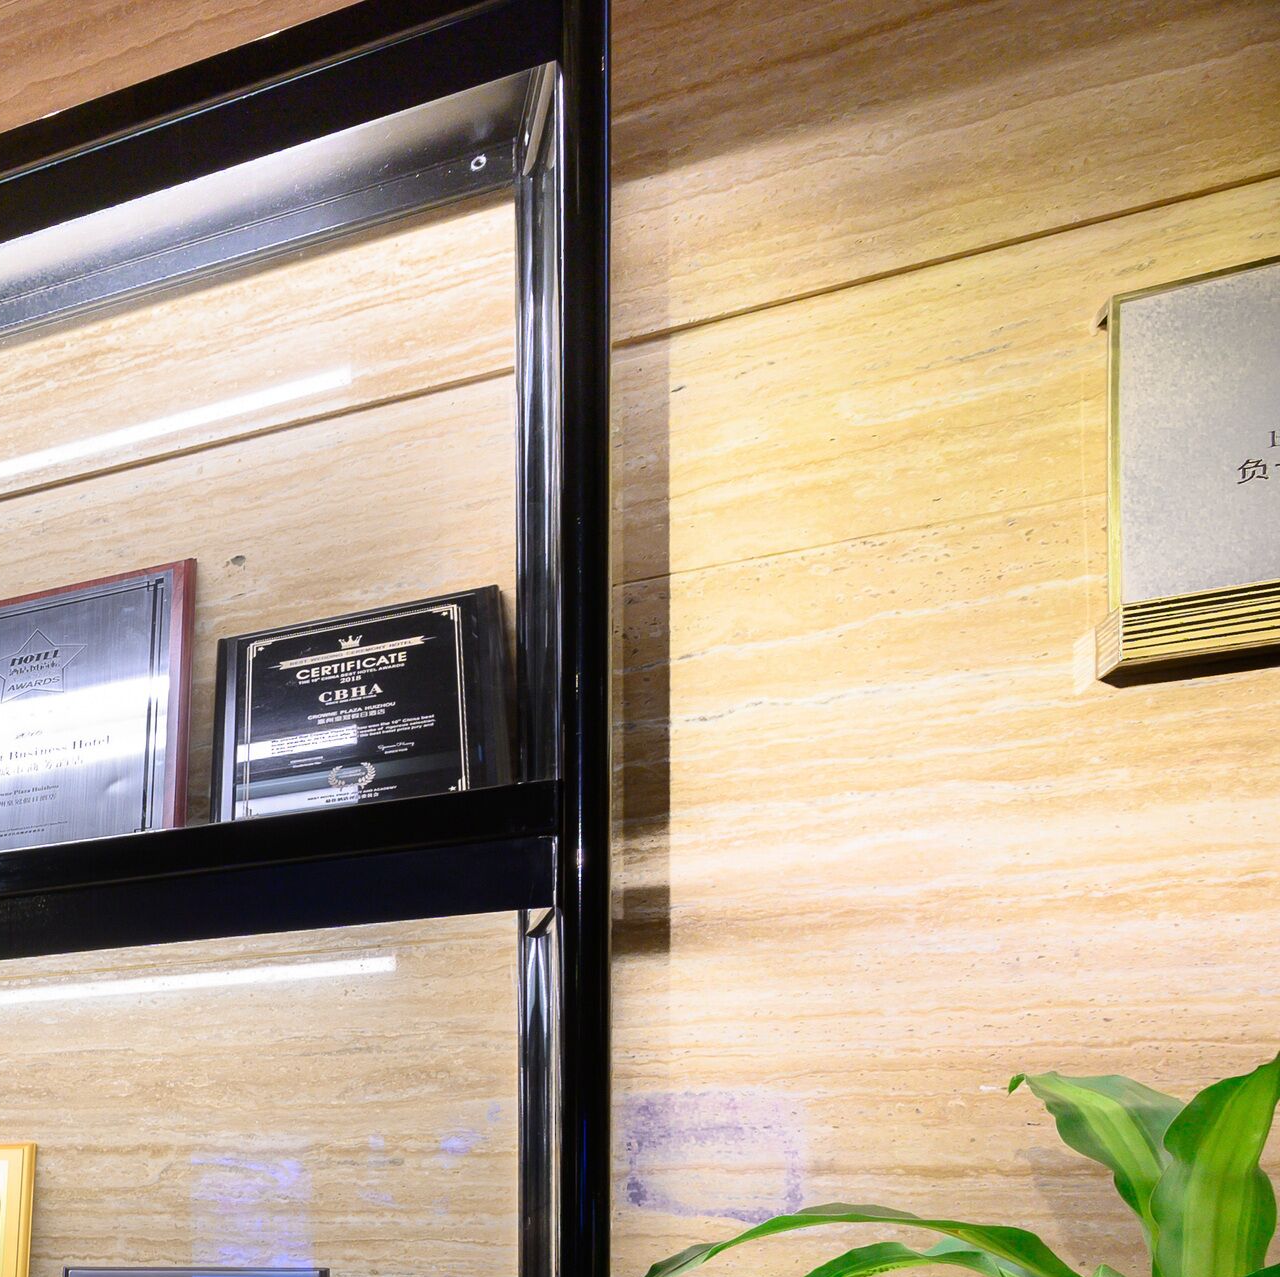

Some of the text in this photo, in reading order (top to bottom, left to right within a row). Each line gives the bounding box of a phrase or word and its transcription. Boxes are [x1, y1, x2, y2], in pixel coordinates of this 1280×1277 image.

[1237, 458, 1280, 485] 负
[296, 651, 408, 680] CERTIFICATE
[7, 676, 61, 692] AWARDS
[318, 683, 384, 703] CBHA
[307, 701, 396, 720] CROWNE PLAZA HUIZHOU
[72, 735, 110, 750] Hotel
